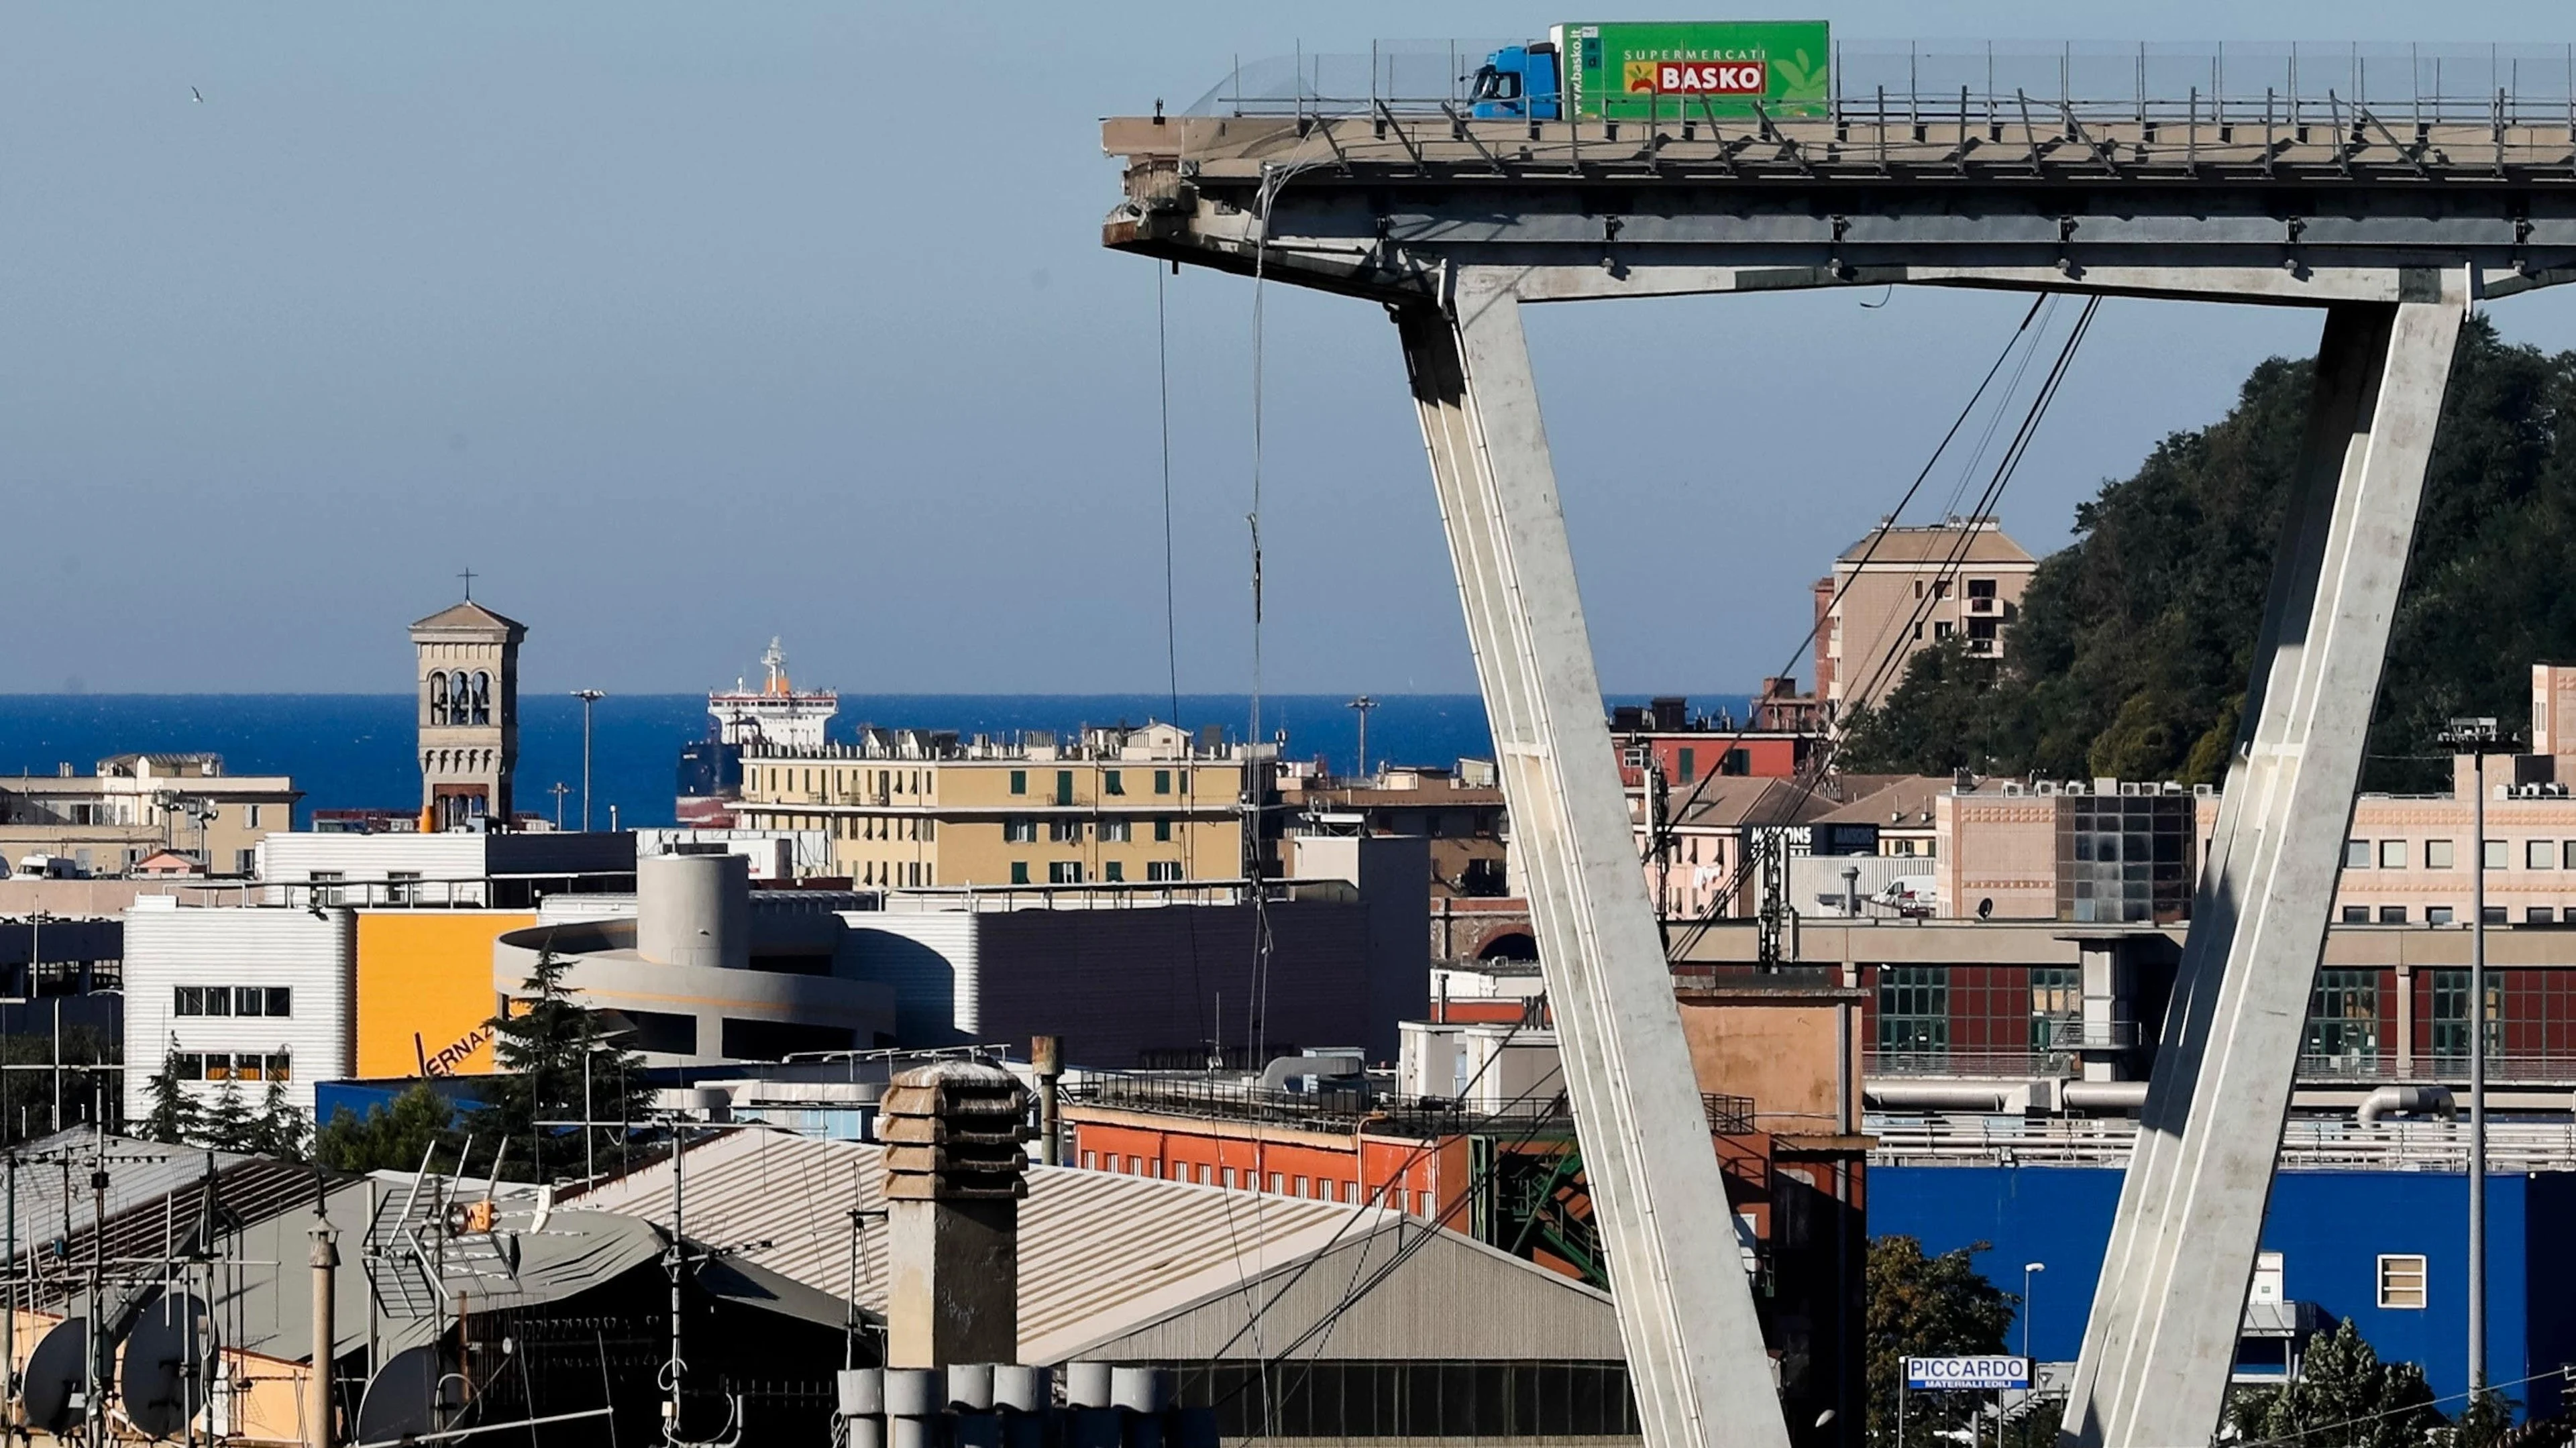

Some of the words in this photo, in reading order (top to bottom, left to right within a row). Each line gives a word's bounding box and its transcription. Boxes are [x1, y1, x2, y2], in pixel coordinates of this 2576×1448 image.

[1624, 50, 1766, 60] SUPERMERCATI
[1662, 67, 1761, 89] BASKO
[1911, 1360, 2023, 1378] PICCARDO
[1925, 1380, 1982, 1388] MATERIALI
[1984, 1380, 2012, 1388] EDILI
